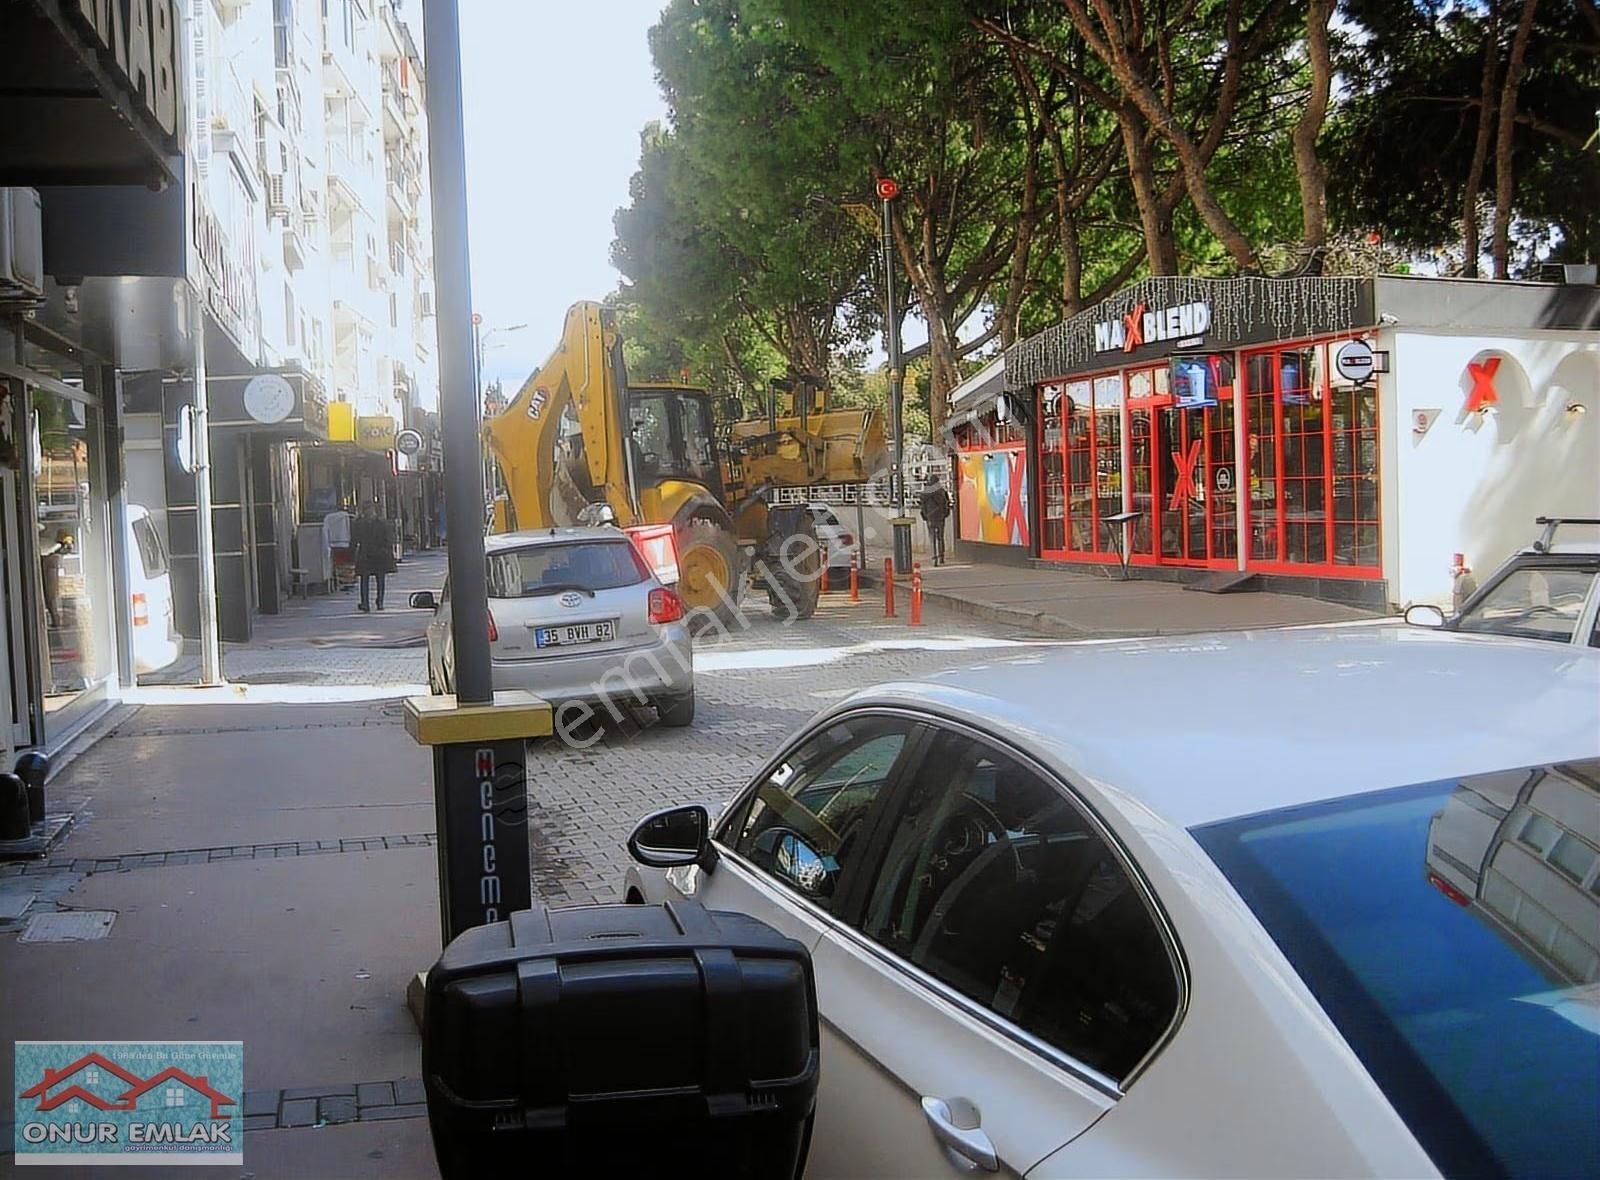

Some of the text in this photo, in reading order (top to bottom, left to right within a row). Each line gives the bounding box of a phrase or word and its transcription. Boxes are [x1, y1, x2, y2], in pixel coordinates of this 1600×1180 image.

[1094, 301, 1212, 353] MAXBLEND
[527, 388, 547, 420] CAT
[543, 628, 559, 644] 35
[567, 625, 590, 641] BVH
[475, 748, 503, 923] Meneme
